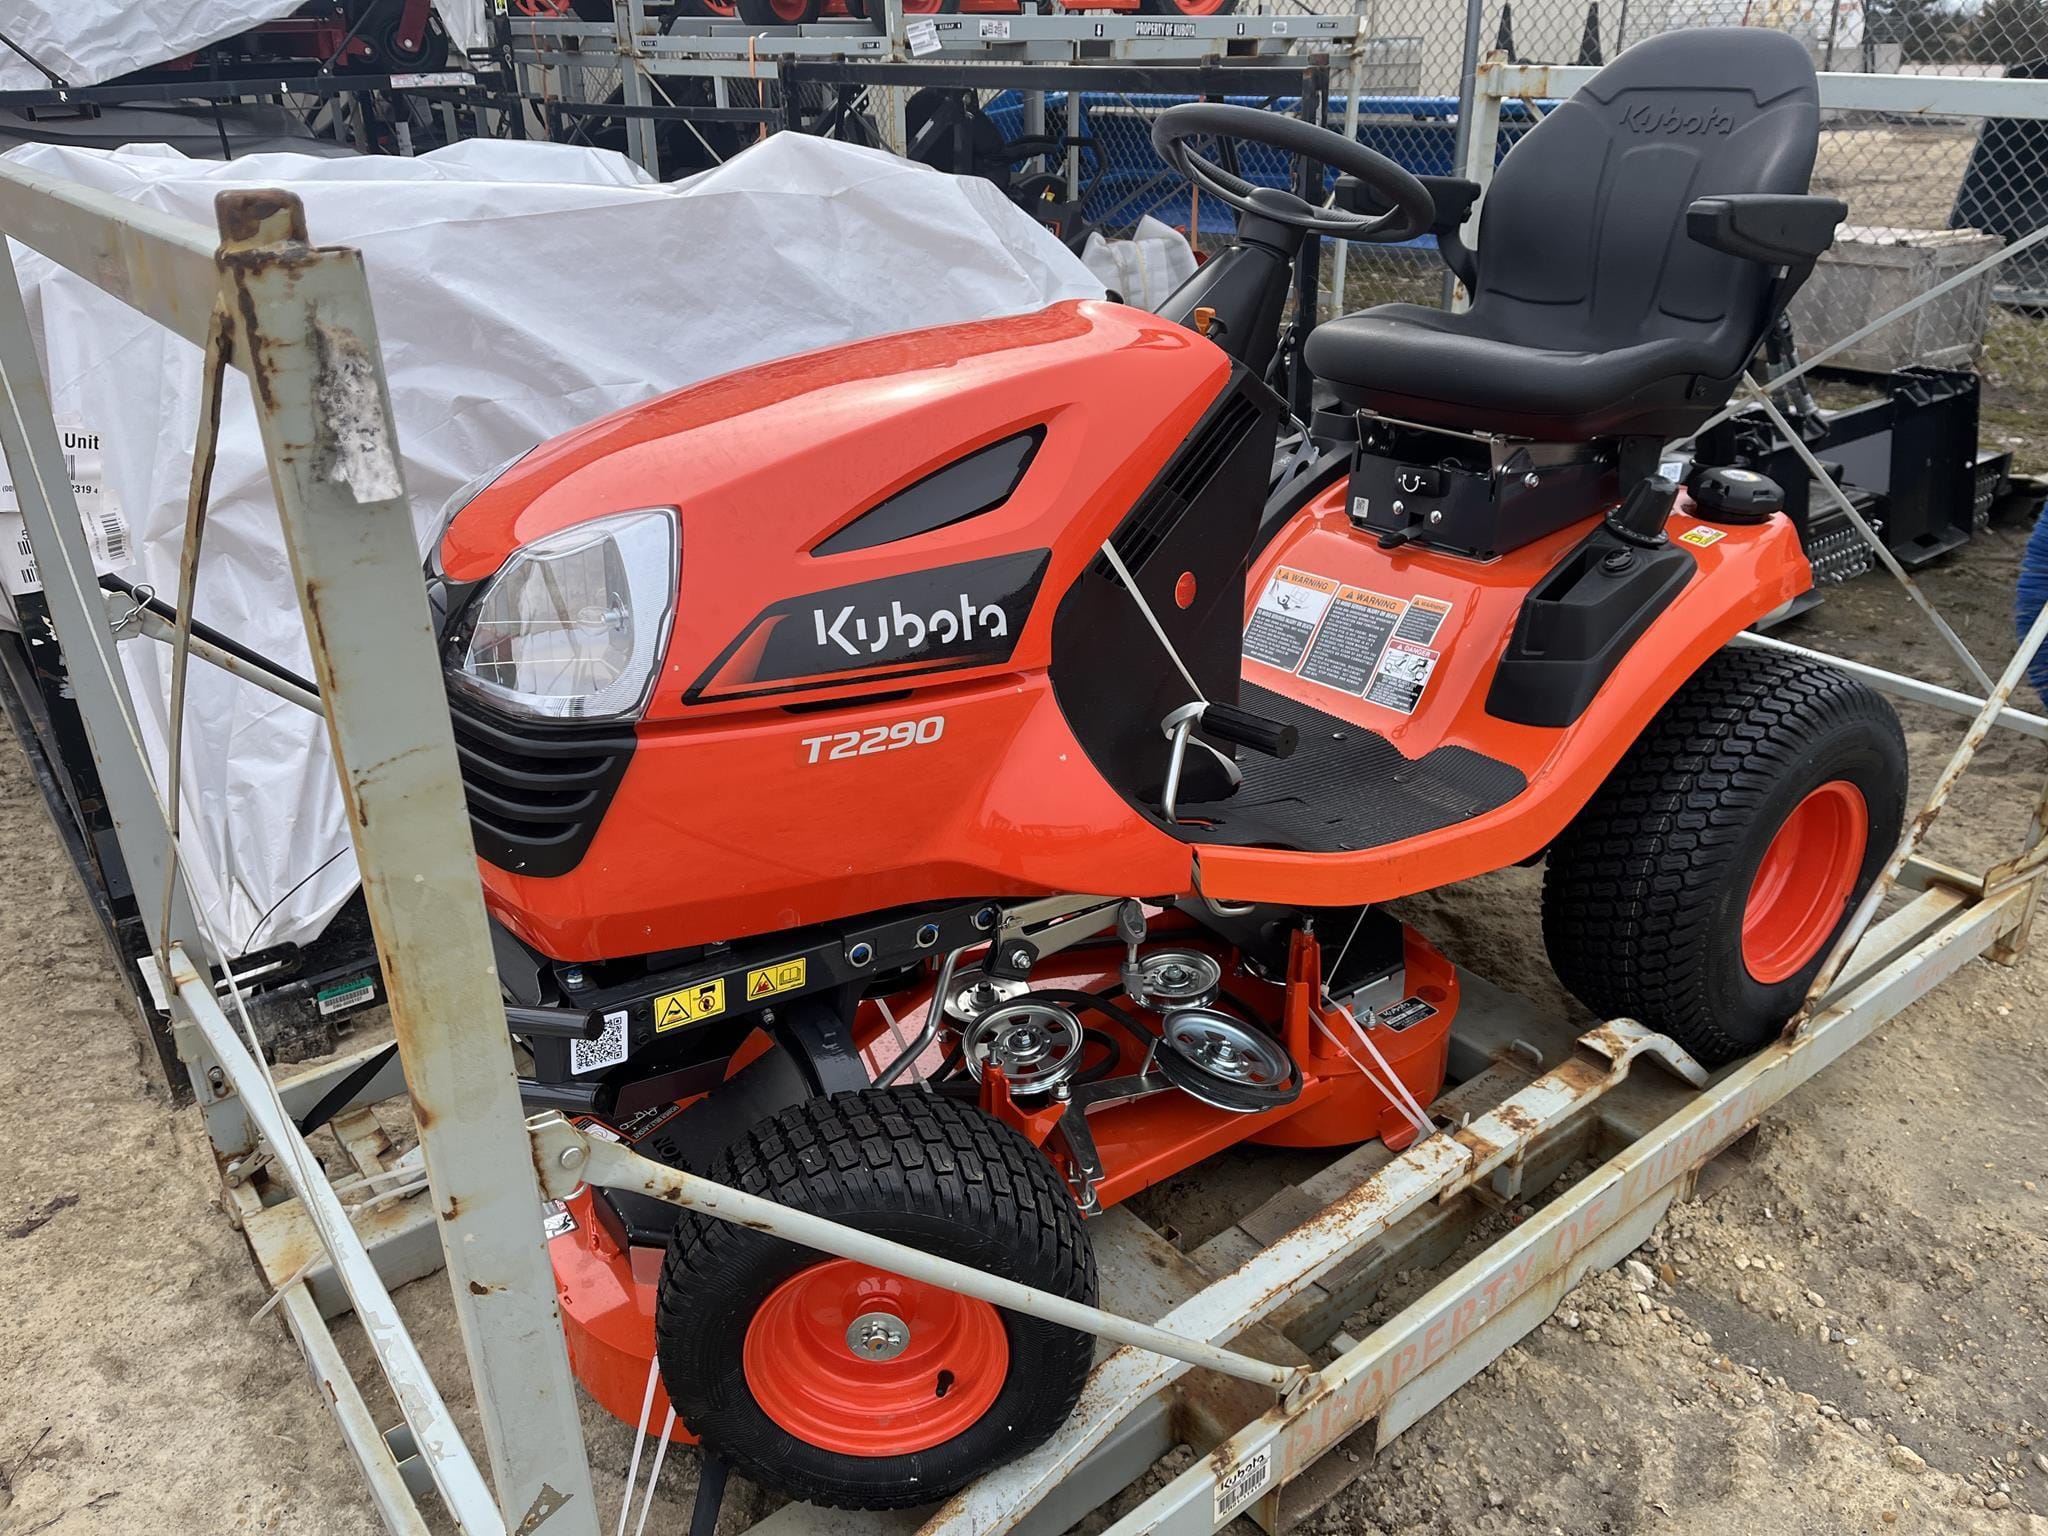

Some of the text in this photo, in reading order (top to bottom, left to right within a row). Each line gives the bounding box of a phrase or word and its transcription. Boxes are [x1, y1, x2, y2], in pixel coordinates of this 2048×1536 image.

[1136, 22, 1195, 37] PROPERTY OF KUBOTA
[1618, 103, 1735, 135] Kubota
[64, 433, 100, 450] Unit
[1291, 573, 1328, 591] WARNING
[1355, 592, 1397, 611] WARNING
[813, 593, 1008, 656] Kubota
[1403, 644, 1431, 658] DANGER
[800, 715, 945, 764] T2290
[1282, 1253, 1536, 1475] PROPERTY
[1553, 1198, 1605, 1262] OF
[1219, 1454, 1265, 1491] Kubota
